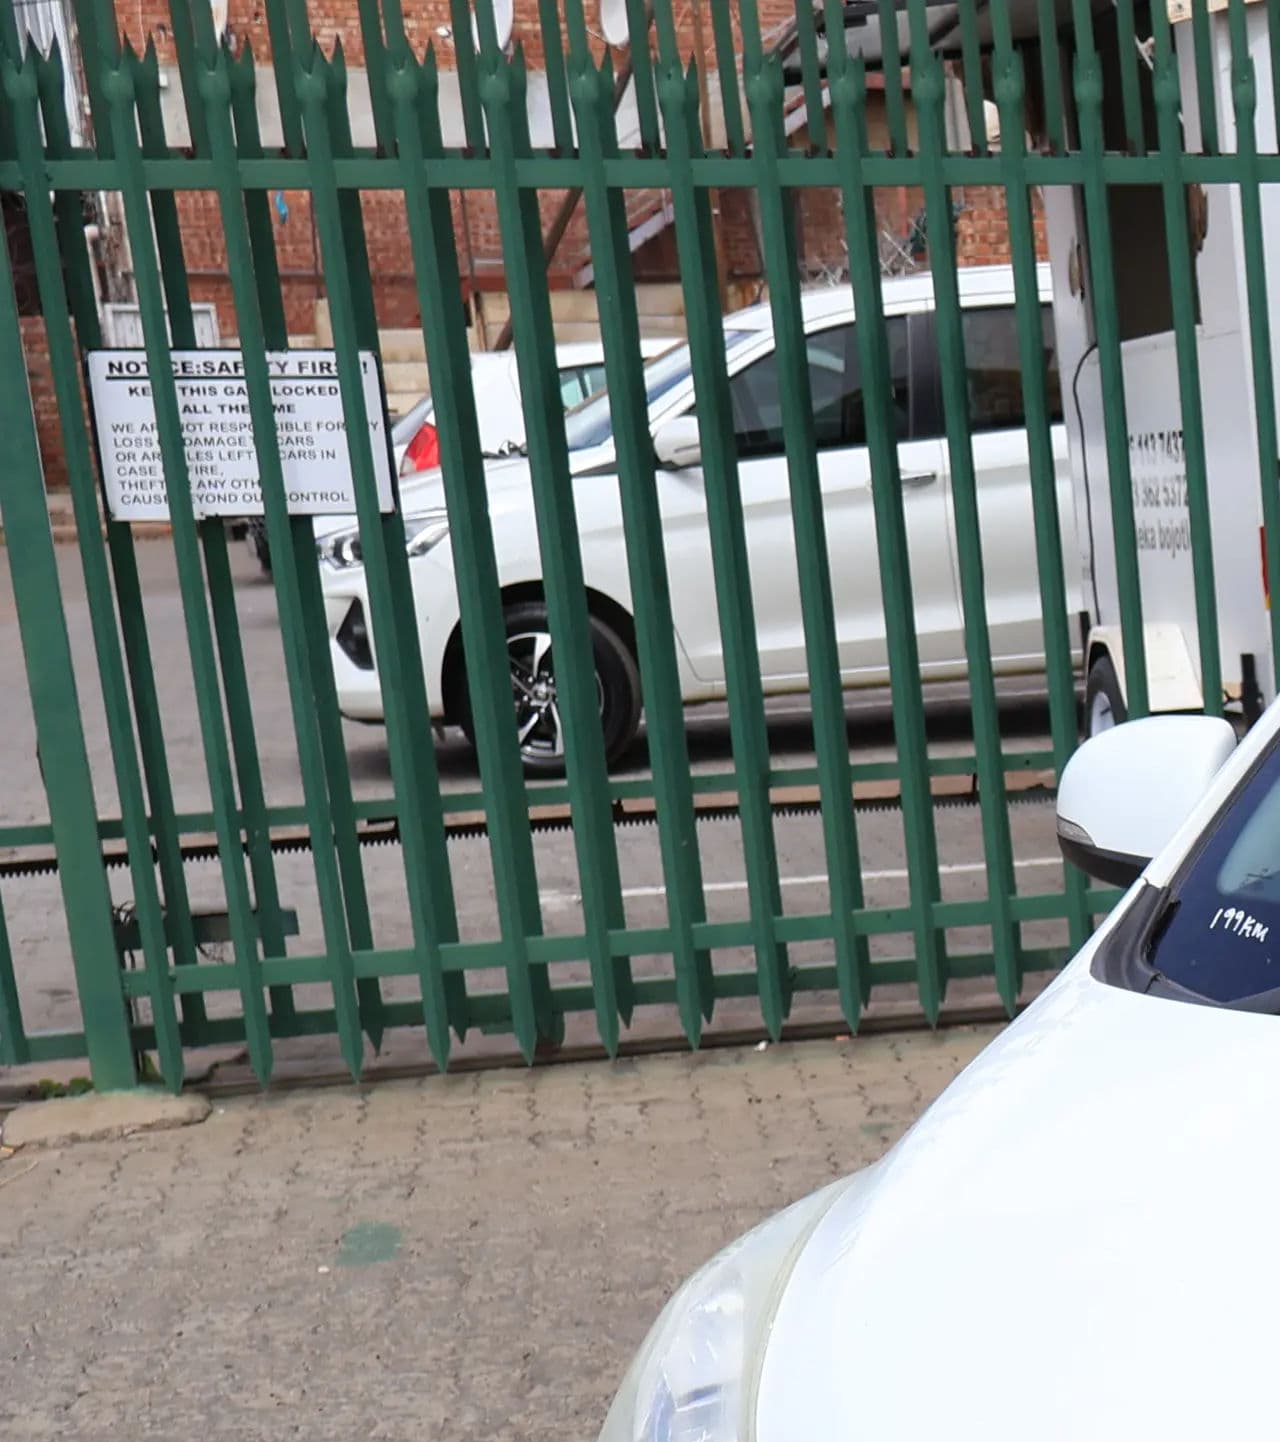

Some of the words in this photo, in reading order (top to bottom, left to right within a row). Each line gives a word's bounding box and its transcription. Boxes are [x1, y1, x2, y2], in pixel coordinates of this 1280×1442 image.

[178, 385, 218, 396] THIS
[272, 385, 339, 396] LOCKED
[182, 403, 212, 414] ALL
[218, 403, 250, 414] THE
[110, 422, 135, 433] WE
[178, 422, 205, 433] OT
[210, 421, 313, 433] RESPIBLE
[317, 421, 348, 432] FOR
[113, 437, 153, 448] LOSS
[183, 436, 247, 448] DAMAGE
[115, 451, 137, 461] OR
[142, 451, 214, 462] ARLES
[219, 450, 253, 461] LEFT
[321, 449, 336, 460] IN
[117, 465, 157, 477] CASE
[119, 479, 165, 490] THEFT
[196, 479, 226, 489] ANY
[231, 478, 267, 489] OTH
[186, 492, 237, 504] YOND
[242, 492, 266, 503] OU
[286, 490, 349, 502] ONTROL
